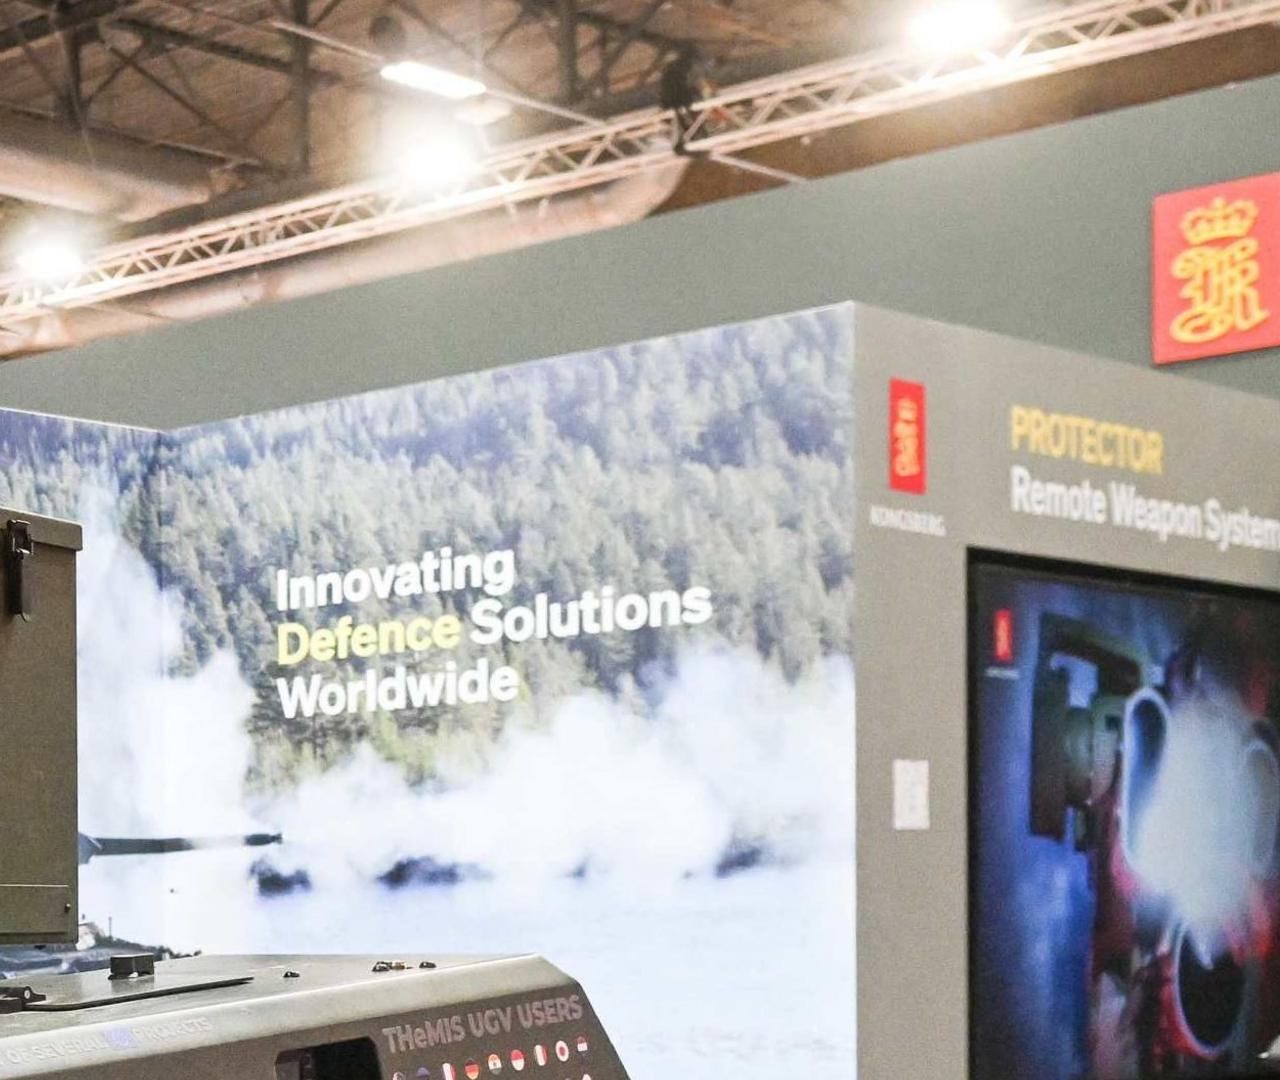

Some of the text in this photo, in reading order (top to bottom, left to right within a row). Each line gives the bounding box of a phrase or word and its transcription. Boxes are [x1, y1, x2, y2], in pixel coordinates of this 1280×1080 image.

[1011, 405, 1163, 475] PROTECTOR
[1010, 465, 1106, 524] Remote
[1111, 480, 1202, 542] Weapon
[276, 545, 515, 612] Innovating
[277, 584, 713, 666] Defence Solutions
[276, 660, 519, 719] Worldwide
[382, 994, 584, 1053] THeMIS UGV USERS
